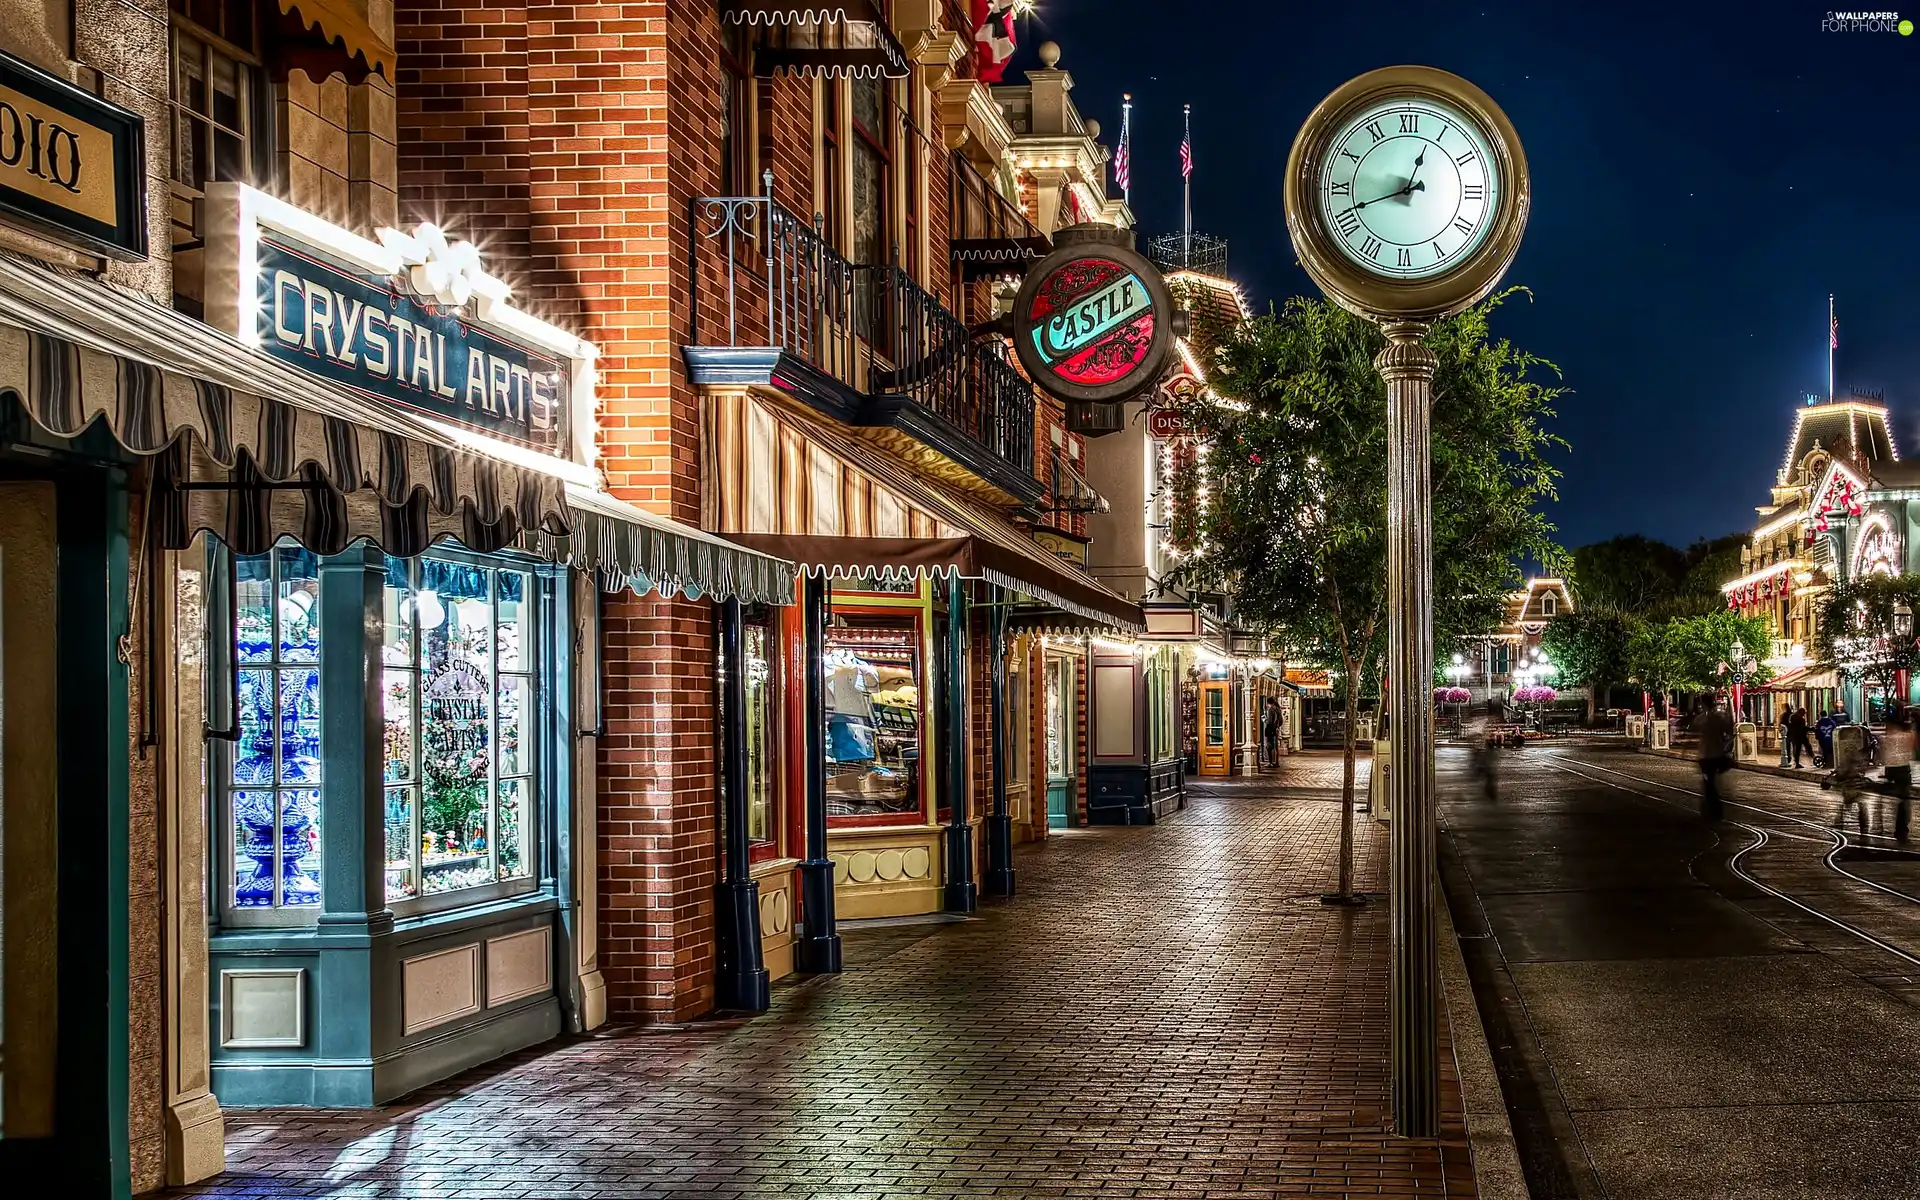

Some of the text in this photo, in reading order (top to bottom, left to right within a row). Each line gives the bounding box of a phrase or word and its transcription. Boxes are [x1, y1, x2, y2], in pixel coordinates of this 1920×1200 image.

[1365, 121, 1386, 143] XI
[1398, 114, 1420, 133] XII
[1436, 125, 1448, 142] I
[1341, 147, 1360, 164] X
[1455, 150, 1475, 167] II
[1331, 181, 1350, 196] IX
[1464, 184, 1482, 200] III
[1335, 208, 1361, 238] VIII
[1454, 217, 1474, 237] IV
[1359, 235, 1382, 260] VII
[1397, 248, 1411, 267] VI
[1432, 241, 1446, 259] V
[1040, 280, 1134, 358] CASTLE
[274, 268, 551, 429] CRYSTAL ARTS
[422, 659, 490, 695] GLASS CUTTERS
[430, 698, 483, 720] CRYSTAL
[443, 729, 476, 752] ARTS
